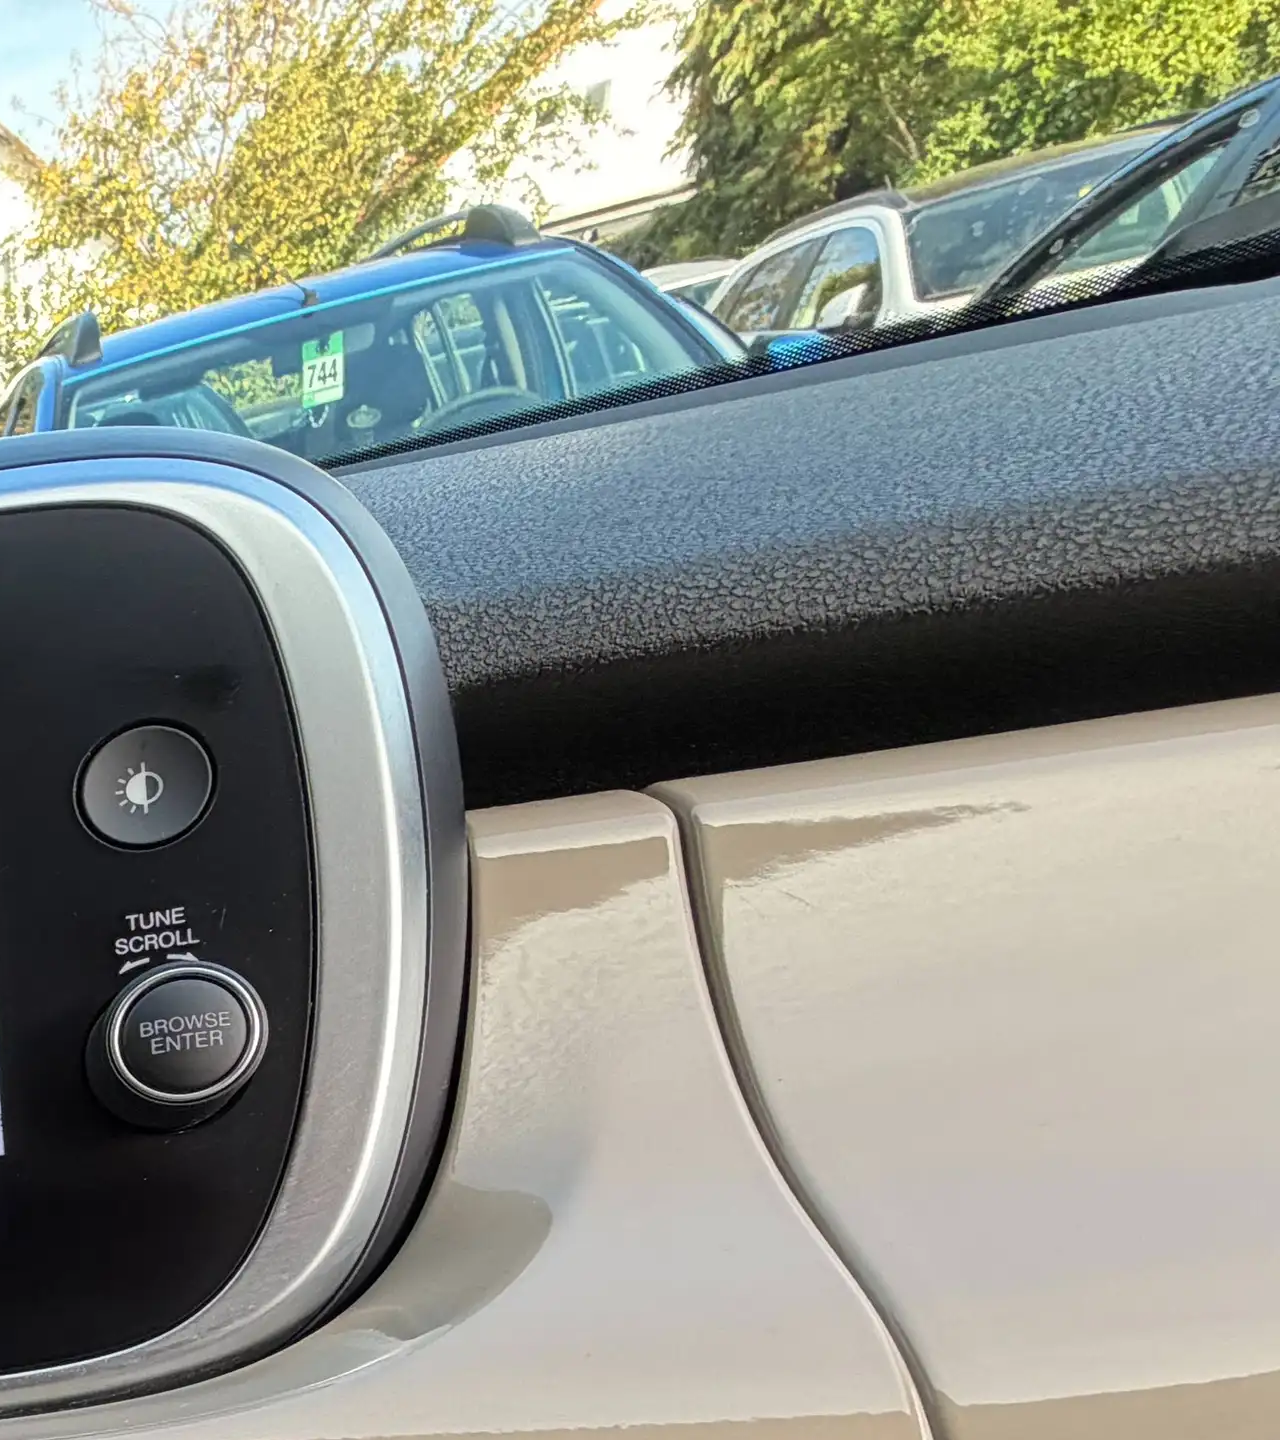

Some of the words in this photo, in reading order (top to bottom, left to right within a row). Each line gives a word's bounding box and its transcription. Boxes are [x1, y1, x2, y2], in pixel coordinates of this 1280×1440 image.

[308, 358, 337, 388] 744
[125, 907, 186, 931] TUNE
[114, 929, 199, 956] SCROLL
[140, 1011, 231, 1038] BROWSE
[150, 1030, 224, 1055] ENTER
